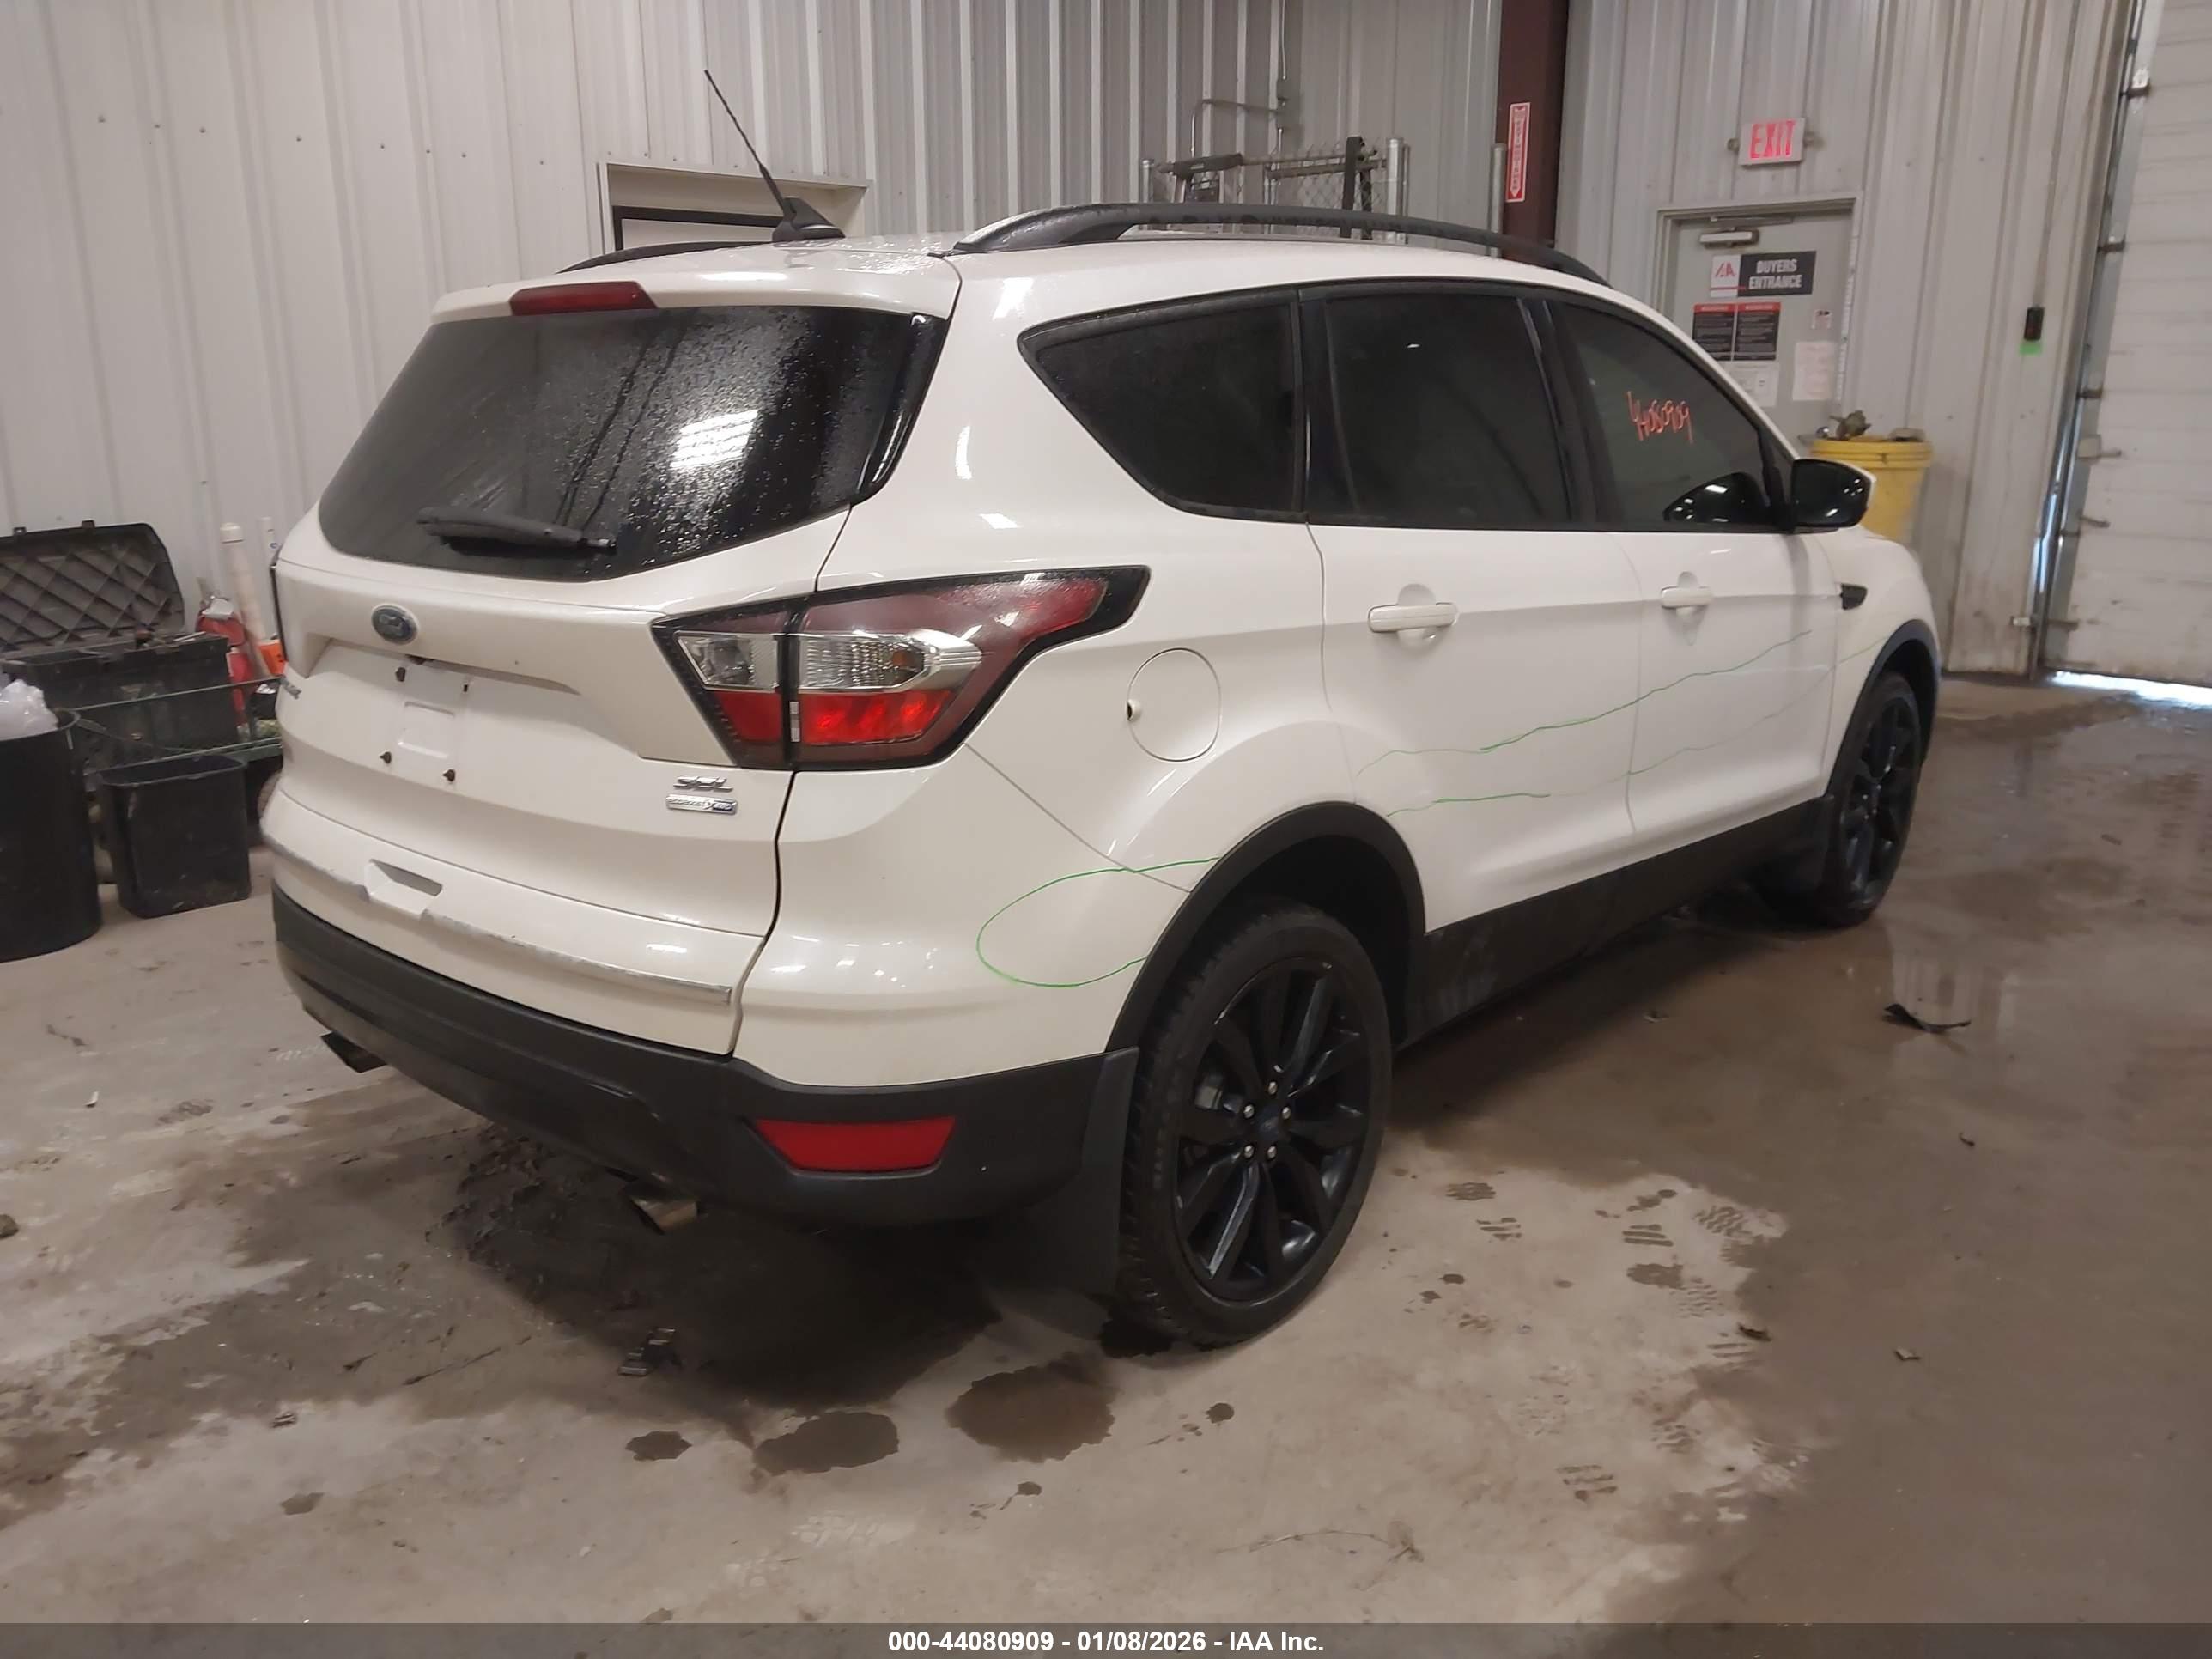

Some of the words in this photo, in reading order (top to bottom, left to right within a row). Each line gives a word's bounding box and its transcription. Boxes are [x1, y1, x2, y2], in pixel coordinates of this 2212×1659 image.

[1750, 119, 1796, 159] EXIT
[1756, 258, 1798, 274] BUYERS
[1748, 274, 1802, 289] ENTRANCE
